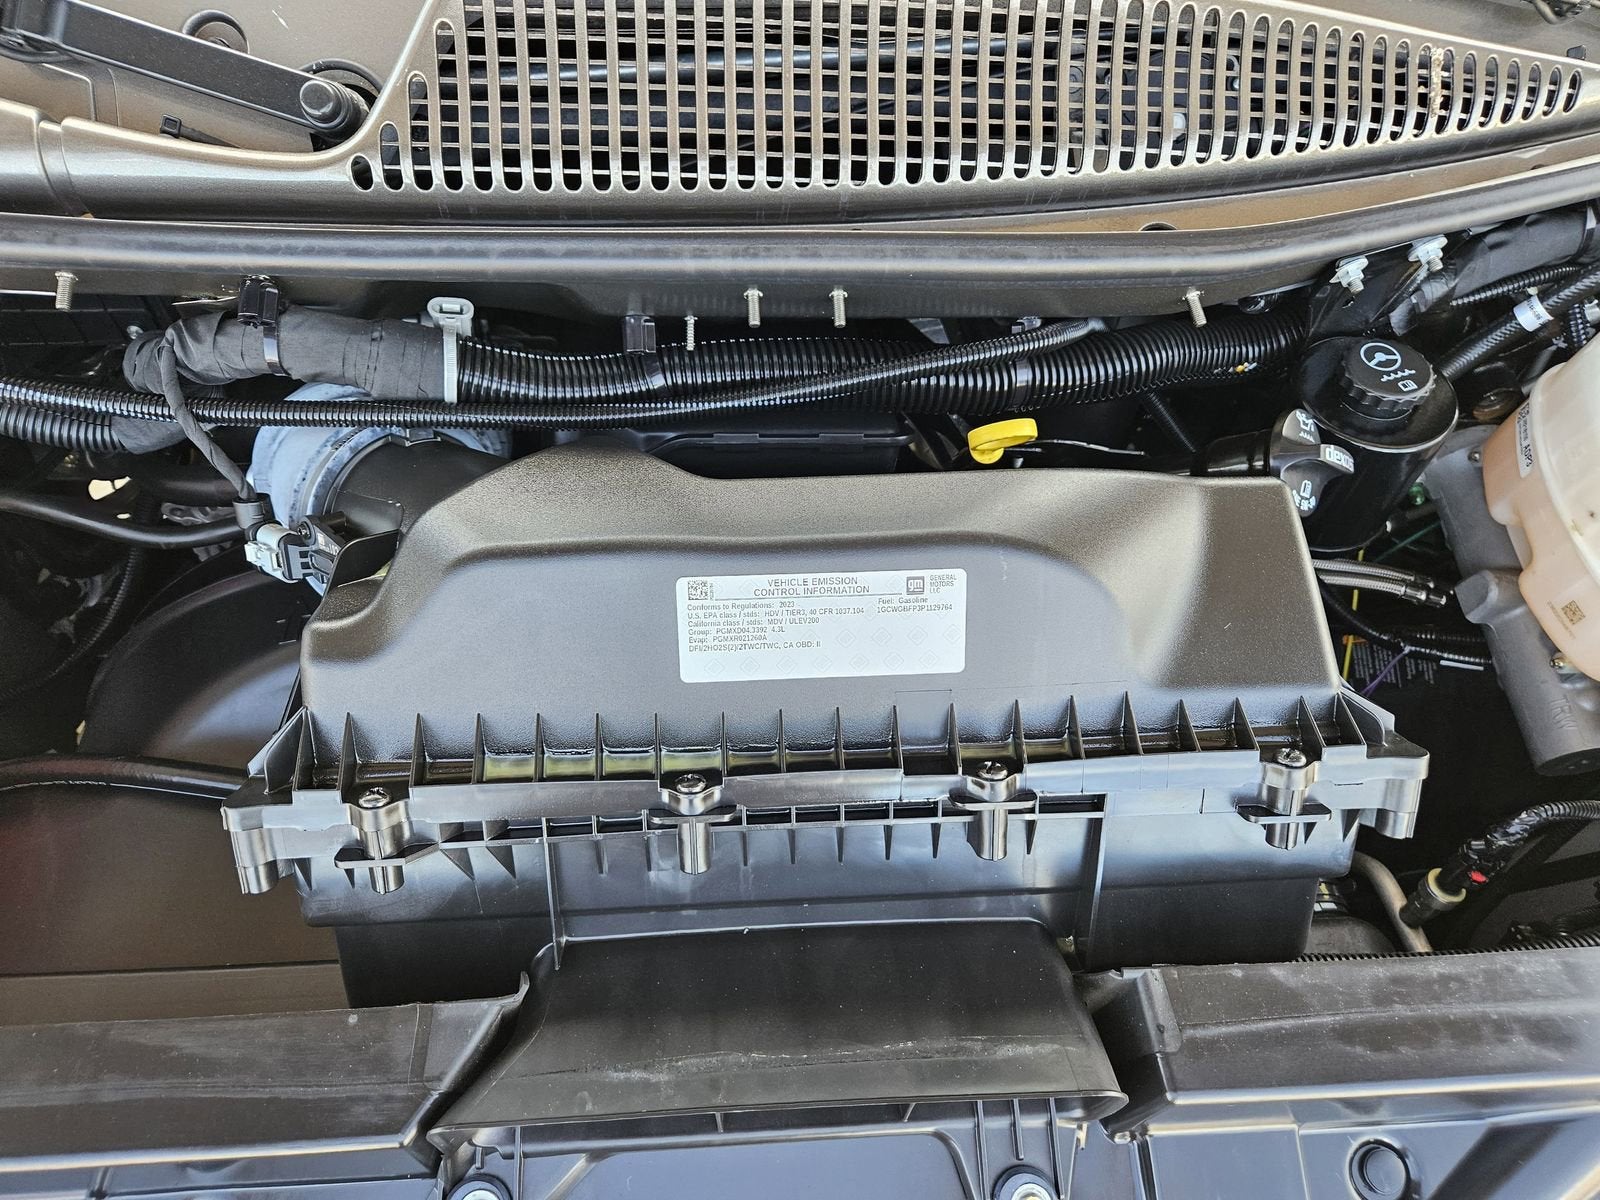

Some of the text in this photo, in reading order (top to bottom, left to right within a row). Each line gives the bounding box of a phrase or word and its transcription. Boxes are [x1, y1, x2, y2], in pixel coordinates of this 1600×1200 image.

[1326, 445, 1354, 471] dexos
[768, 577, 858, 587] VEHICLE EMISSION
[907, 577, 924, 592] gm
[754, 585, 870, 596] CONTROL INFORMATION
[731, 602, 775, 611] Regulations:
[743, 610, 760, 618] stds:
[764, 609, 780, 617] HDV
[785, 608, 807, 616] TIER3,
[746, 618, 763, 626] stds:
[688, 628, 712, 636] Group:
[716, 627, 768, 635] PGMXD04.3392
[713, 634, 768, 643] PGMXR021260A
